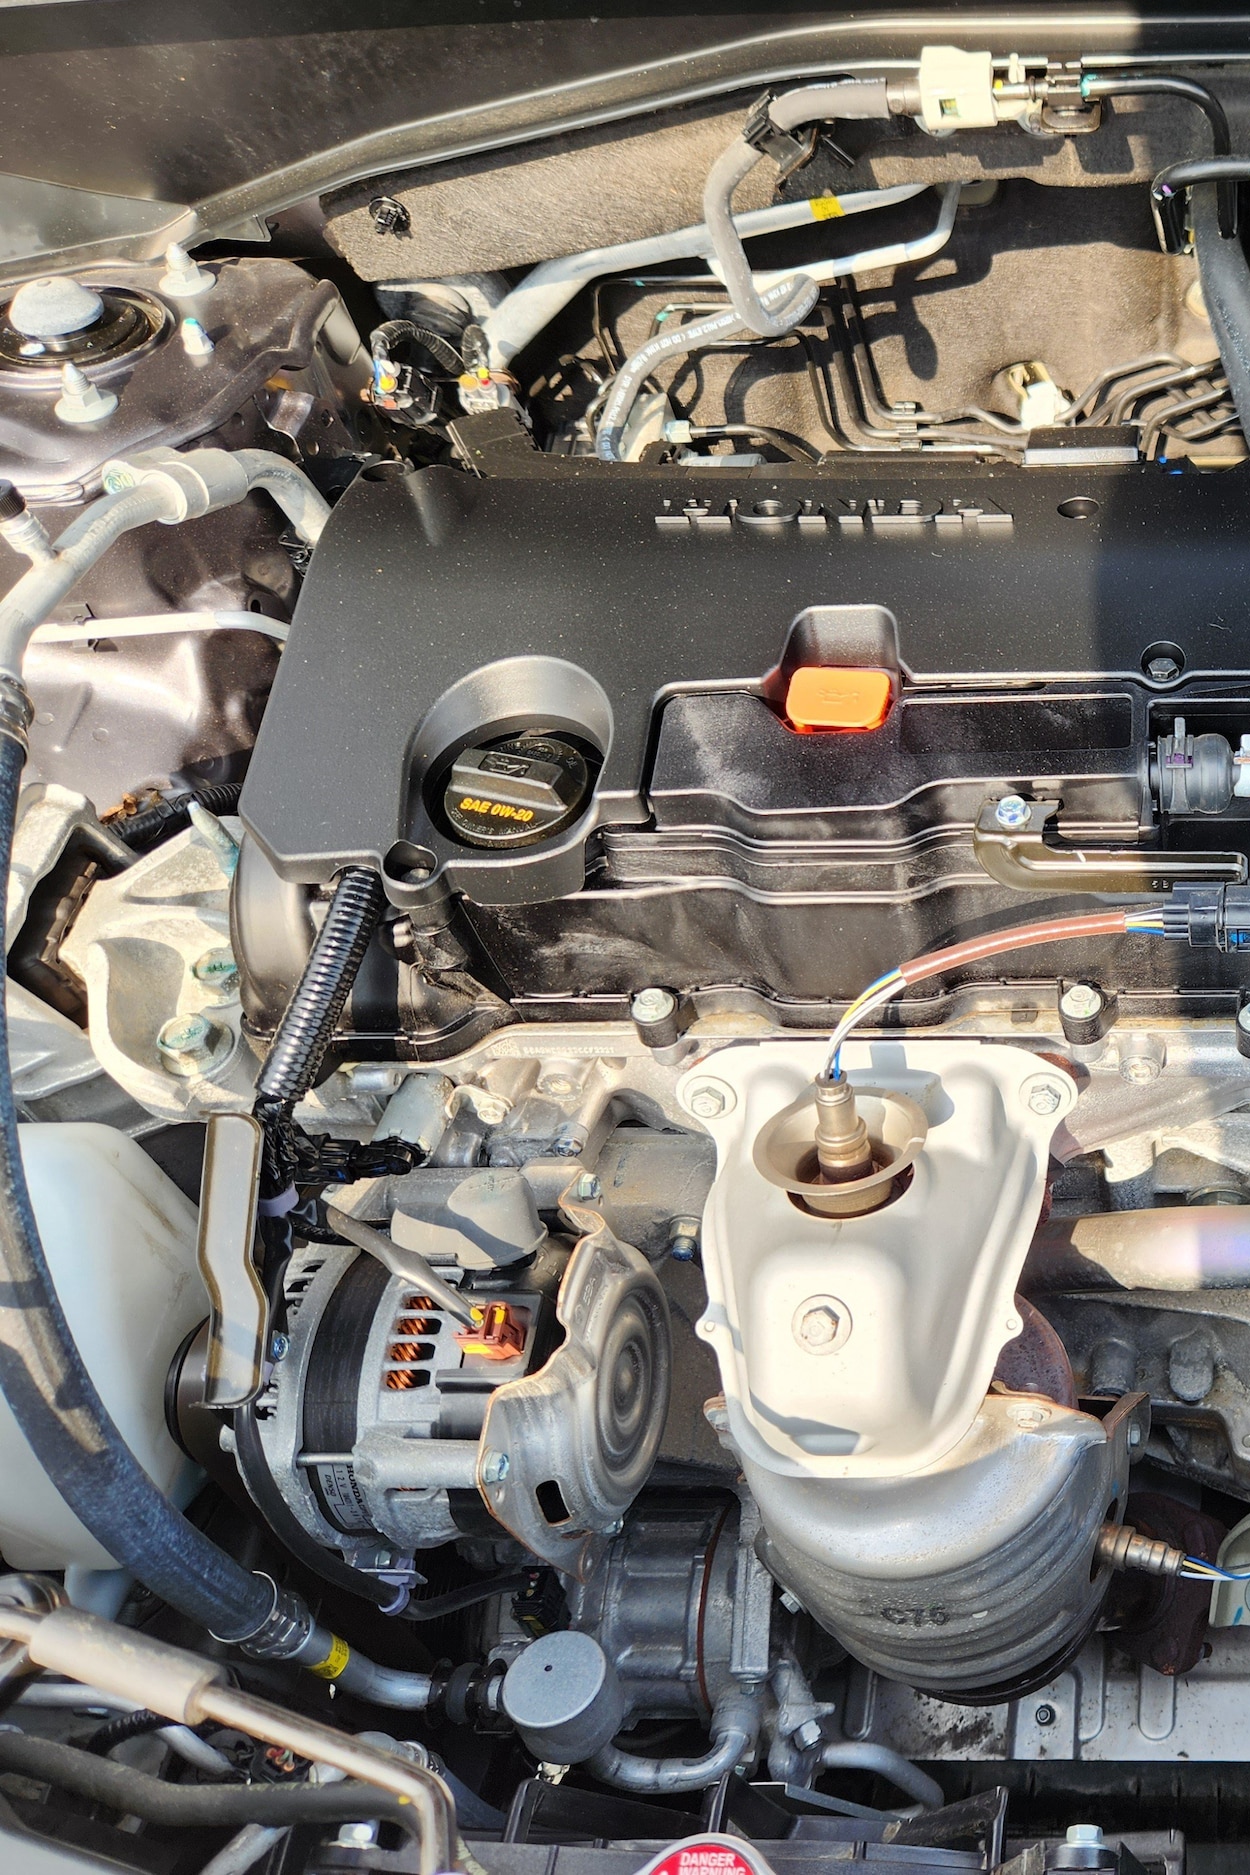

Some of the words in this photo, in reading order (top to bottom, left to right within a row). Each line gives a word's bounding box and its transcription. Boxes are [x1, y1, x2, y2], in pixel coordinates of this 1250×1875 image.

[654, 497, 1014, 524] HONDA
[460, 797, 491, 815] SAE
[490, 804, 534, 822] 0W-20
[324, 1474, 337, 1497] DENSO
[346, 1464, 364, 1505] HONDA
[680, 1852, 736, 1867] DANGER
